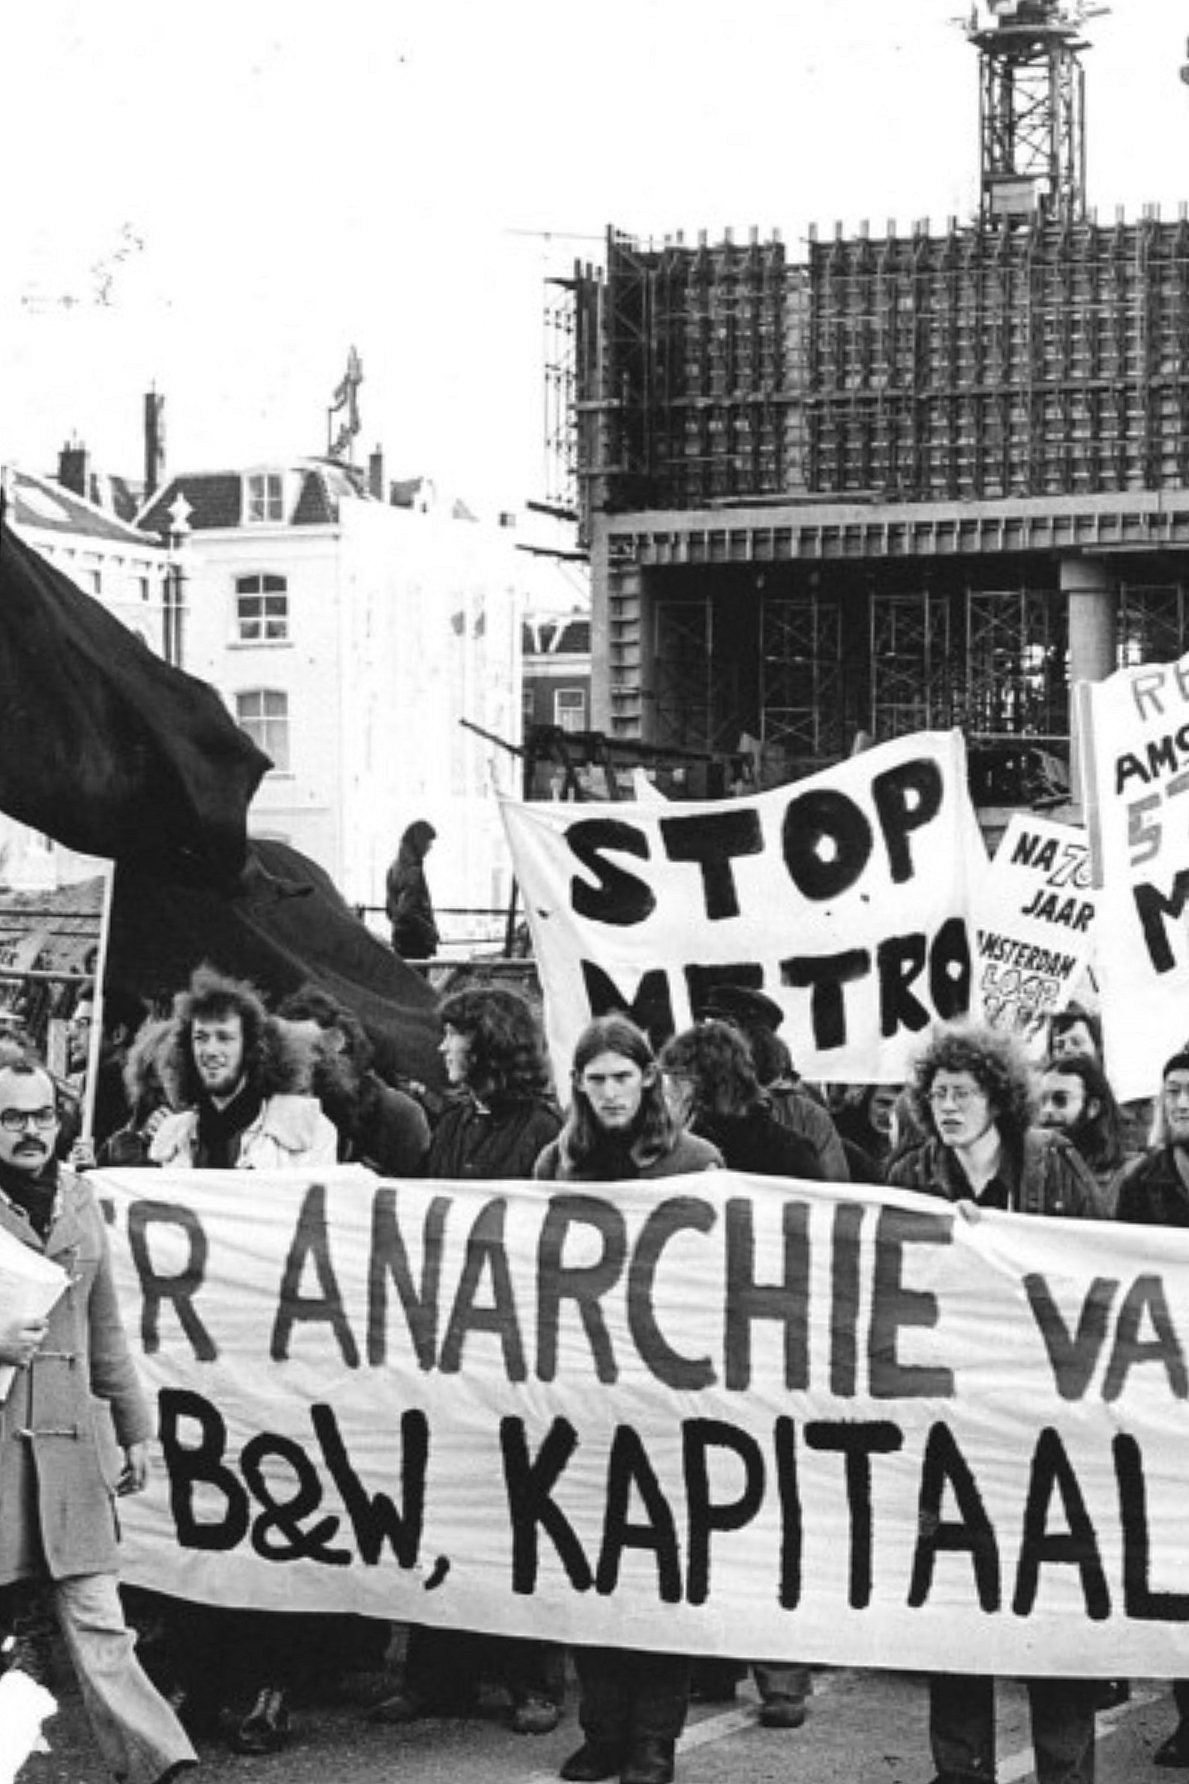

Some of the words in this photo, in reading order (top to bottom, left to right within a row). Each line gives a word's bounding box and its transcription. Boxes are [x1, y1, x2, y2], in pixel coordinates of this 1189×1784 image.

[564, 757, 943, 926] STOP
[1010, 831, 1060, 872] NA
[1021, 889, 1095, 933] JAAR
[270, 1184, 955, 1398] ANARCHIE
[157, 1387, 450, 1591] B&W,
